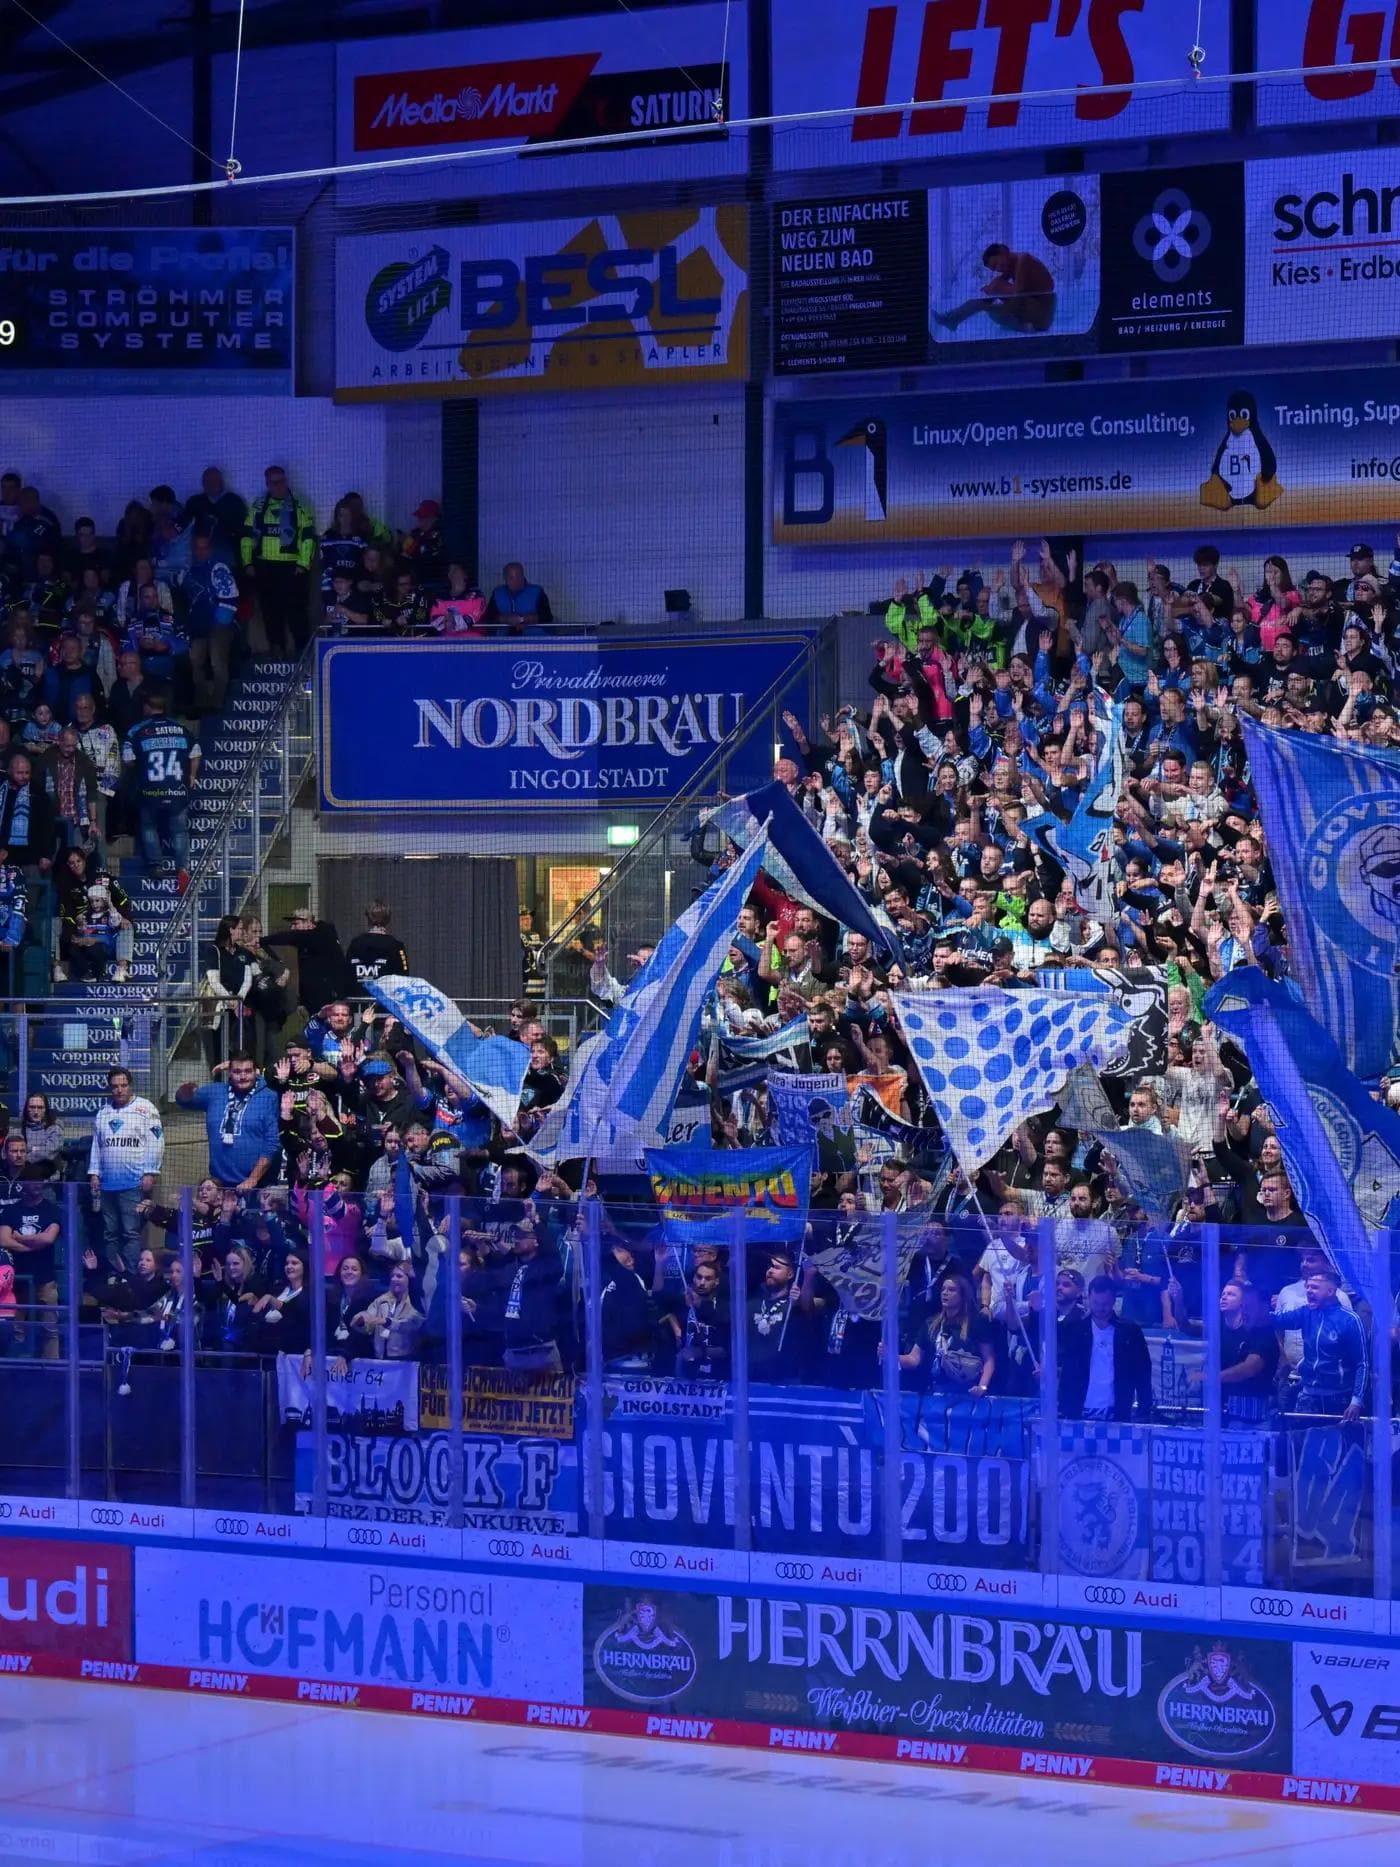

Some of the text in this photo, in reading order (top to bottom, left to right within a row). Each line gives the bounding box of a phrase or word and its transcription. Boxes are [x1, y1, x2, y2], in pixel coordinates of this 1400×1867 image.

[851, 0, 1145, 143] LET'S
[370, 82, 559, 128] Media Markt
[631, 89, 722, 125] SATURN
[781, 200, 910, 227] DER EINFACHSTE
[781, 227, 855, 249] WEG ZUM
[73, 246, 133, 271] die
[781, 249, 873, 273] NEUEN BAD
[1273, 261, 1320, 287] Kies
[50, 285, 283, 305] STRÖHMER
[461, 246, 722, 330] BESL
[1132, 290, 1212, 310] elements
[49, 311, 283, 327] COMPUTER
[61, 333, 271, 349] SYSTEME
[1275, 405, 1360, 427] Training,
[912, 413, 1195, 447] Linux/Open Source Consulting,
[950, 472, 1132, 498] www.b1-systems.de
[511, 660, 669, 690] Privatbrauerei
[413, 692, 745, 759] NORDBRÄU
[148, 751, 183, 782] 34
[509, 767, 670, 789] INGOLSTADT
[41, 1073, 109, 1089] NORDBRÄ
[105, 1136, 140, 1148] SATURN
[365, 1369, 384, 1385] 64
[623, 1379, 724, 1399] GIOVANETTI
[622, 1400, 723, 1419] INGOLSTADT
[519, 1440, 561, 1510] F
[1152, 1463, 1262, 1501] EISHOKEY
[19, 1505, 55, 1520] Audi
[129, 1512, 165, 1528] Audi
[306, 1501, 369, 1520] ERZ
[430, 1512, 564, 1535] FNKURVE
[255, 1522, 292, 1538] Audi
[389, 1530, 426, 1548] Audi
[531, 1544, 570, 1561] Audi
[1153, 1537, 1263, 1586] 204
[673, 1555, 715, 1573] Audi
[820, 1565, 863, 1583] Audi
[368, 1573, 495, 1617] Personal
[974, 1577, 1017, 1595] Audi
[1134, 1591, 1178, 1608] Audi
[1301, 1602, 1347, 1620] Audi
[717, 1595, 1142, 1699] HERRNBRÄU
[80, 1660, 140, 1681] PENNY
[603, 1650, 691, 1672] HERRNBRÄU
[189, 1670, 249, 1691] PENNY
[298, 1682, 360, 1703] PENNY
[411, 1694, 474, 1715] PENNY
[807, 1687, 1045, 1740] Weißbier-Spezialitäten
[1169, 1701, 1269, 1727] HERRNBRÄU
[527, 1705, 590, 1727] PENNY
[647, 1716, 713, 1739] PENNY
[769, 1728, 837, 1750] PENNY
[898, 1739, 968, 1763] PENNY
[1020, 1753, 1093, 1776] PENNY
[1156, 1765, 1230, 1790] PENNY
[1282, 1777, 1360, 1804] PENNY
